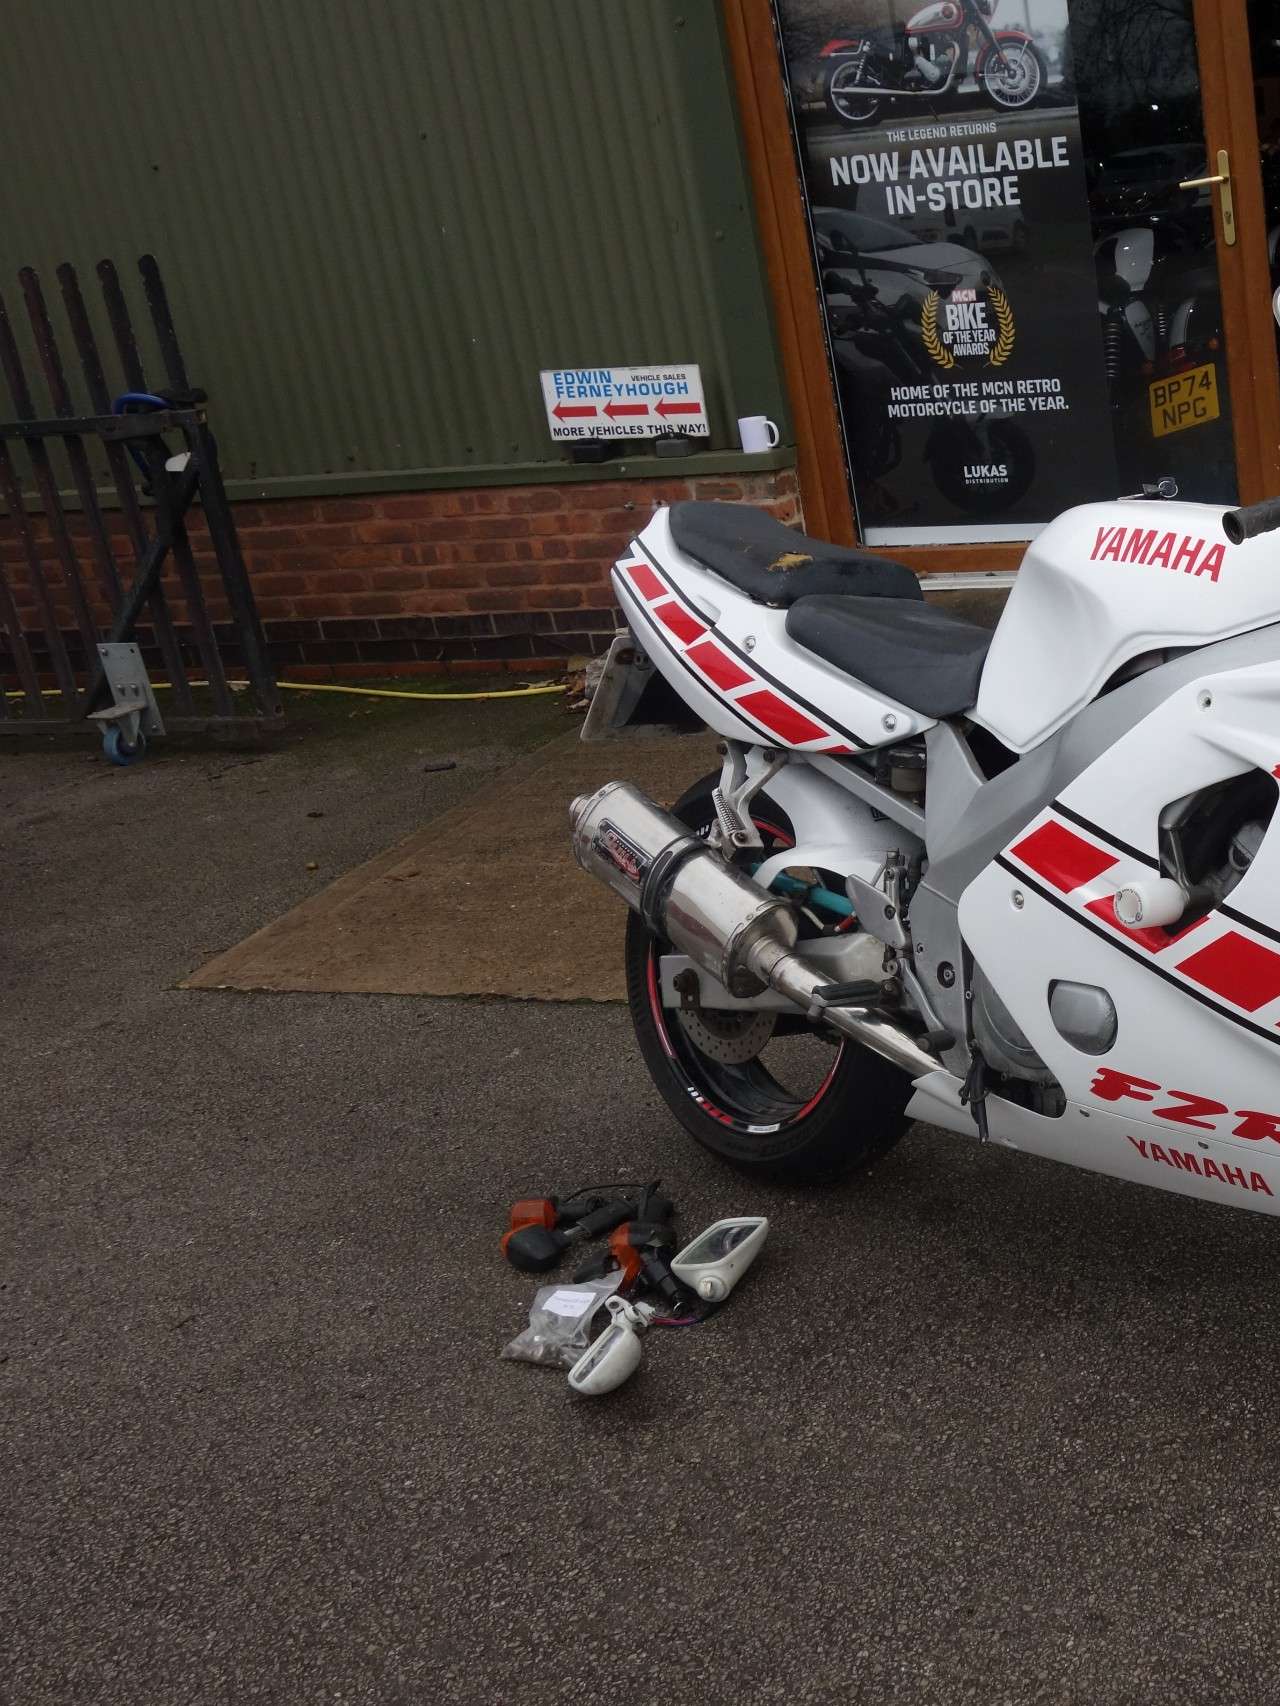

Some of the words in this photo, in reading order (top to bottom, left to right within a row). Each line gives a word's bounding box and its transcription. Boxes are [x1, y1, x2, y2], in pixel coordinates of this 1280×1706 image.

[886, 131, 906, 143] THE
[908, 126, 947, 141] LEGEND
[949, 122, 997, 137] RETURNS
[829, 151, 899, 186] NOW
[908, 136, 1070, 180] AVAILABLE
[885, 175, 1021, 215] IN-STORE
[952, 289, 977, 302] MCN
[945, 302, 989, 331] BIKE
[943, 331, 955, 344] OF
[956, 331, 971, 343] THE
[971, 329, 996, 343] YEAR
[953, 343, 990, 357] AWARDS
[553, 371, 612, 386] EDWIN
[630, 374, 662, 382] VEHICLE
[662, 373, 687, 381] SALES
[555, 381, 689, 399] FERNEYHOUGH
[890, 385, 931, 401] HOME
[933, 384, 950, 399] OF
[952, 382, 979, 397] THE
[981, 380, 1014, 396] MCN
[1016, 378, 1061, 394] RETRO
[1153, 371, 1212, 408] BP74
[887, 400, 977, 419] MOTORCYCLE
[979, 399, 998, 414] OF
[1000, 397, 1027, 413] THE
[1028, 395, 1070, 411] YEAR.
[1163, 396, 1207, 429] NPG
[553, 426, 585, 437] MORE
[588, 425, 644, 437] VEHICLES
[648, 424, 674, 435] THIS
[677, 423, 707, 434] WAY!
[963, 464, 1008, 478] LUKAS
[1090, 526, 1226, 583] YAMAHA
[1126, 1135, 1275, 1197] YAMAHA
